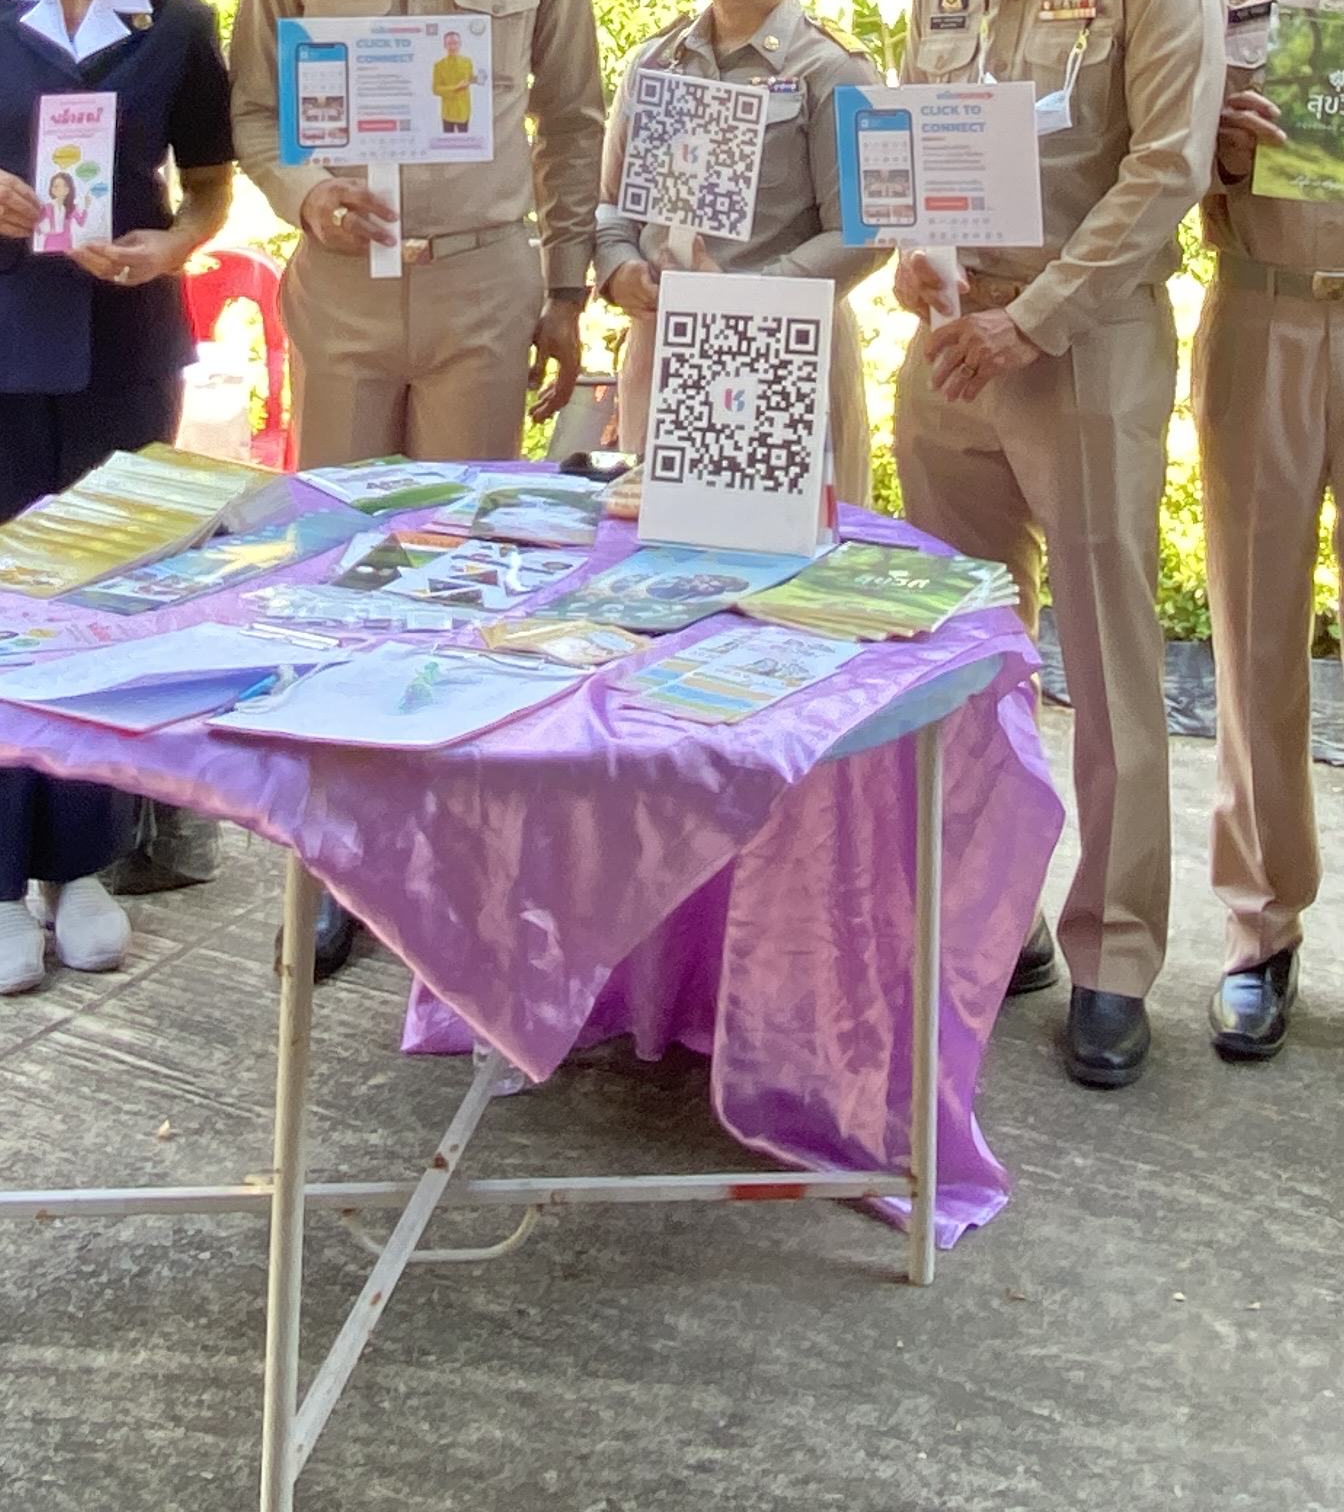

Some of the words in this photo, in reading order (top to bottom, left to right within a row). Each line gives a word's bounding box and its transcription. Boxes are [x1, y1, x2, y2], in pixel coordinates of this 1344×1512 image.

[920, 105, 961, 117] CLICK
[962, 104, 982, 116] TO
[921, 121, 987, 133] CONNECT
